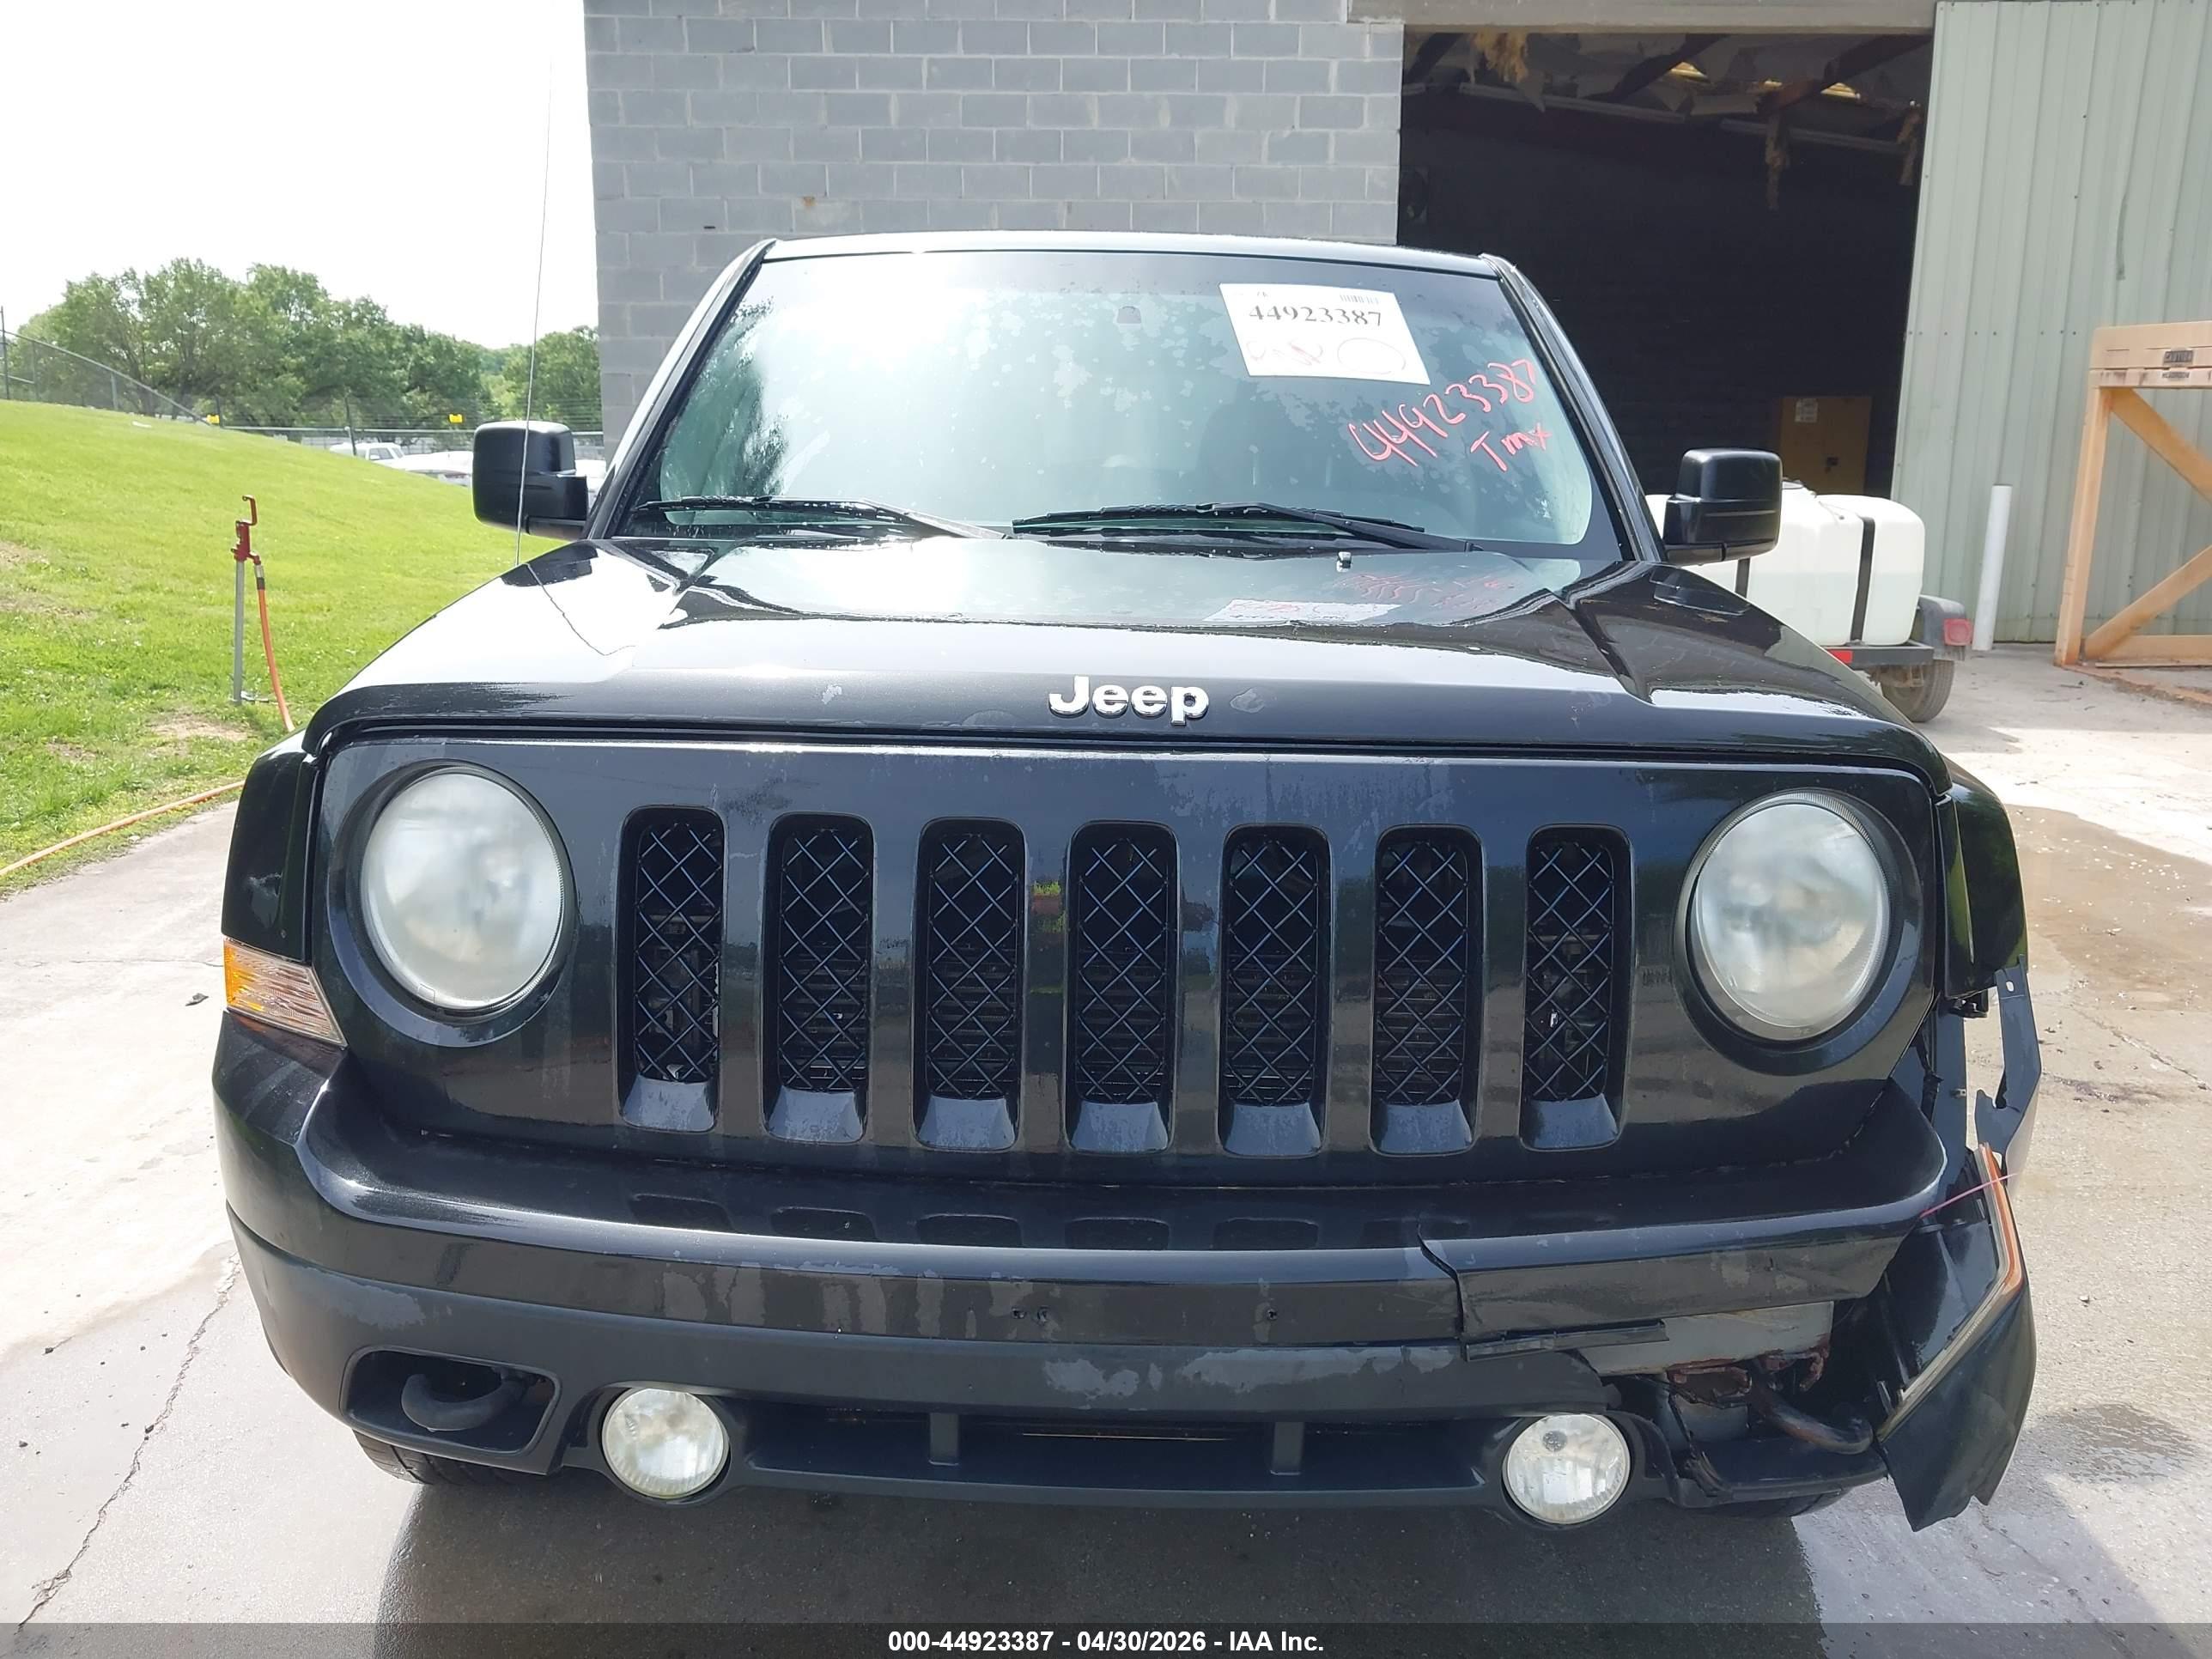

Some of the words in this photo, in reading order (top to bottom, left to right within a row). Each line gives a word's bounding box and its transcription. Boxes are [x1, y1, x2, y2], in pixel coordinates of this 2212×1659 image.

[1249, 305, 1382, 326] 44923387
[1348, 359, 1536, 467] 44923387
[1048, 675, 1209, 726] Jeep
